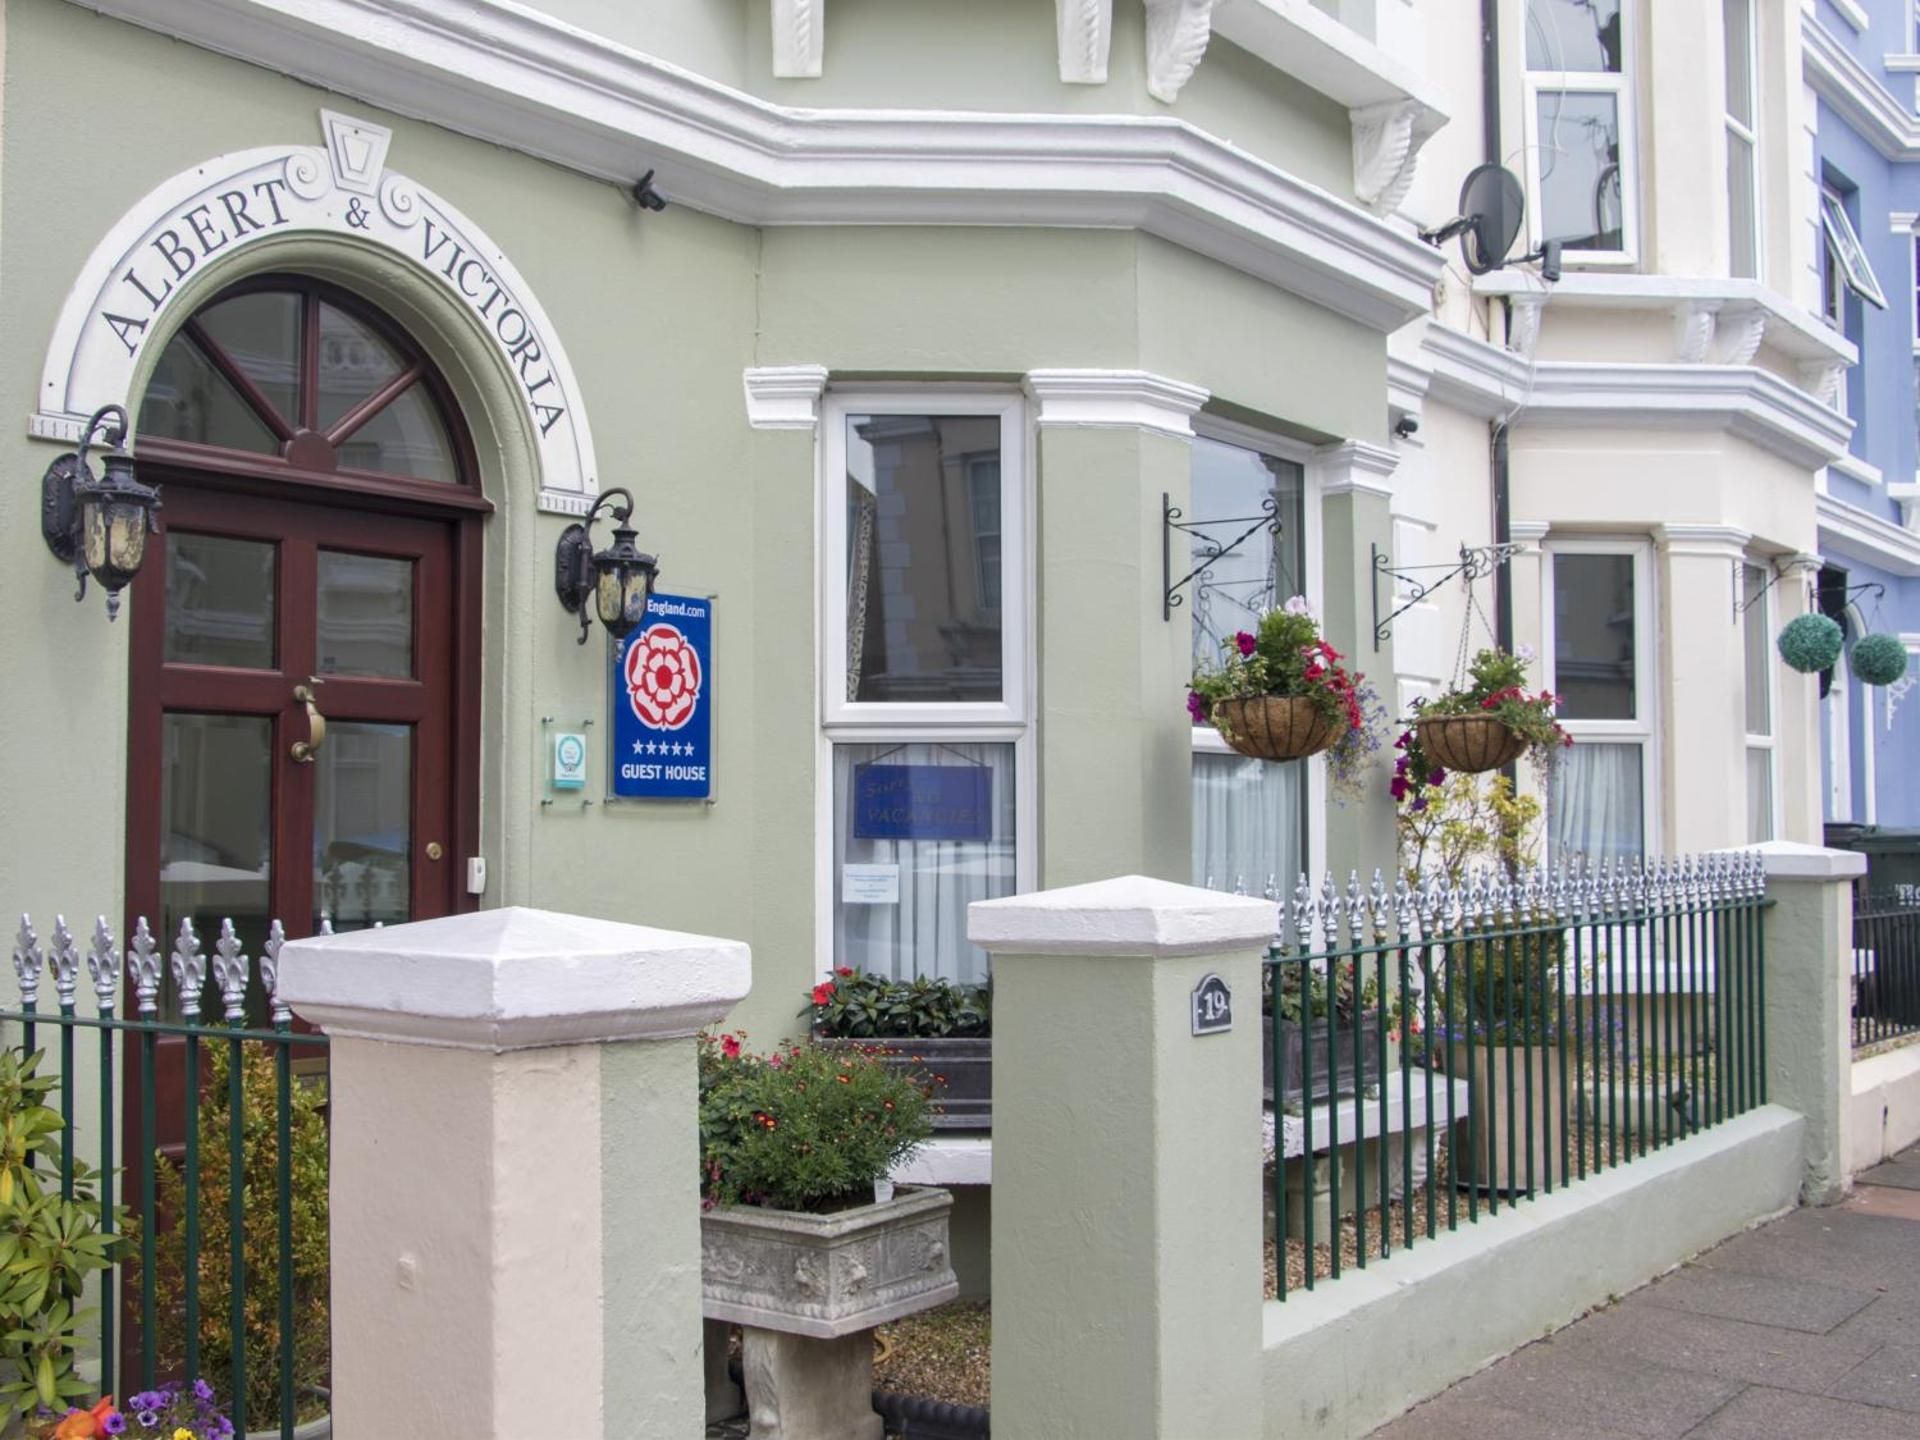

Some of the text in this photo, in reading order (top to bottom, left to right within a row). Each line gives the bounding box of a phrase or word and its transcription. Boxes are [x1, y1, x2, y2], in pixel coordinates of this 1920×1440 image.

[101, 178, 566, 440] ALBERT & VICTORIA
[621, 762, 706, 781] GUEST HOUSE
[1204, 990, 1226, 1020] 19
